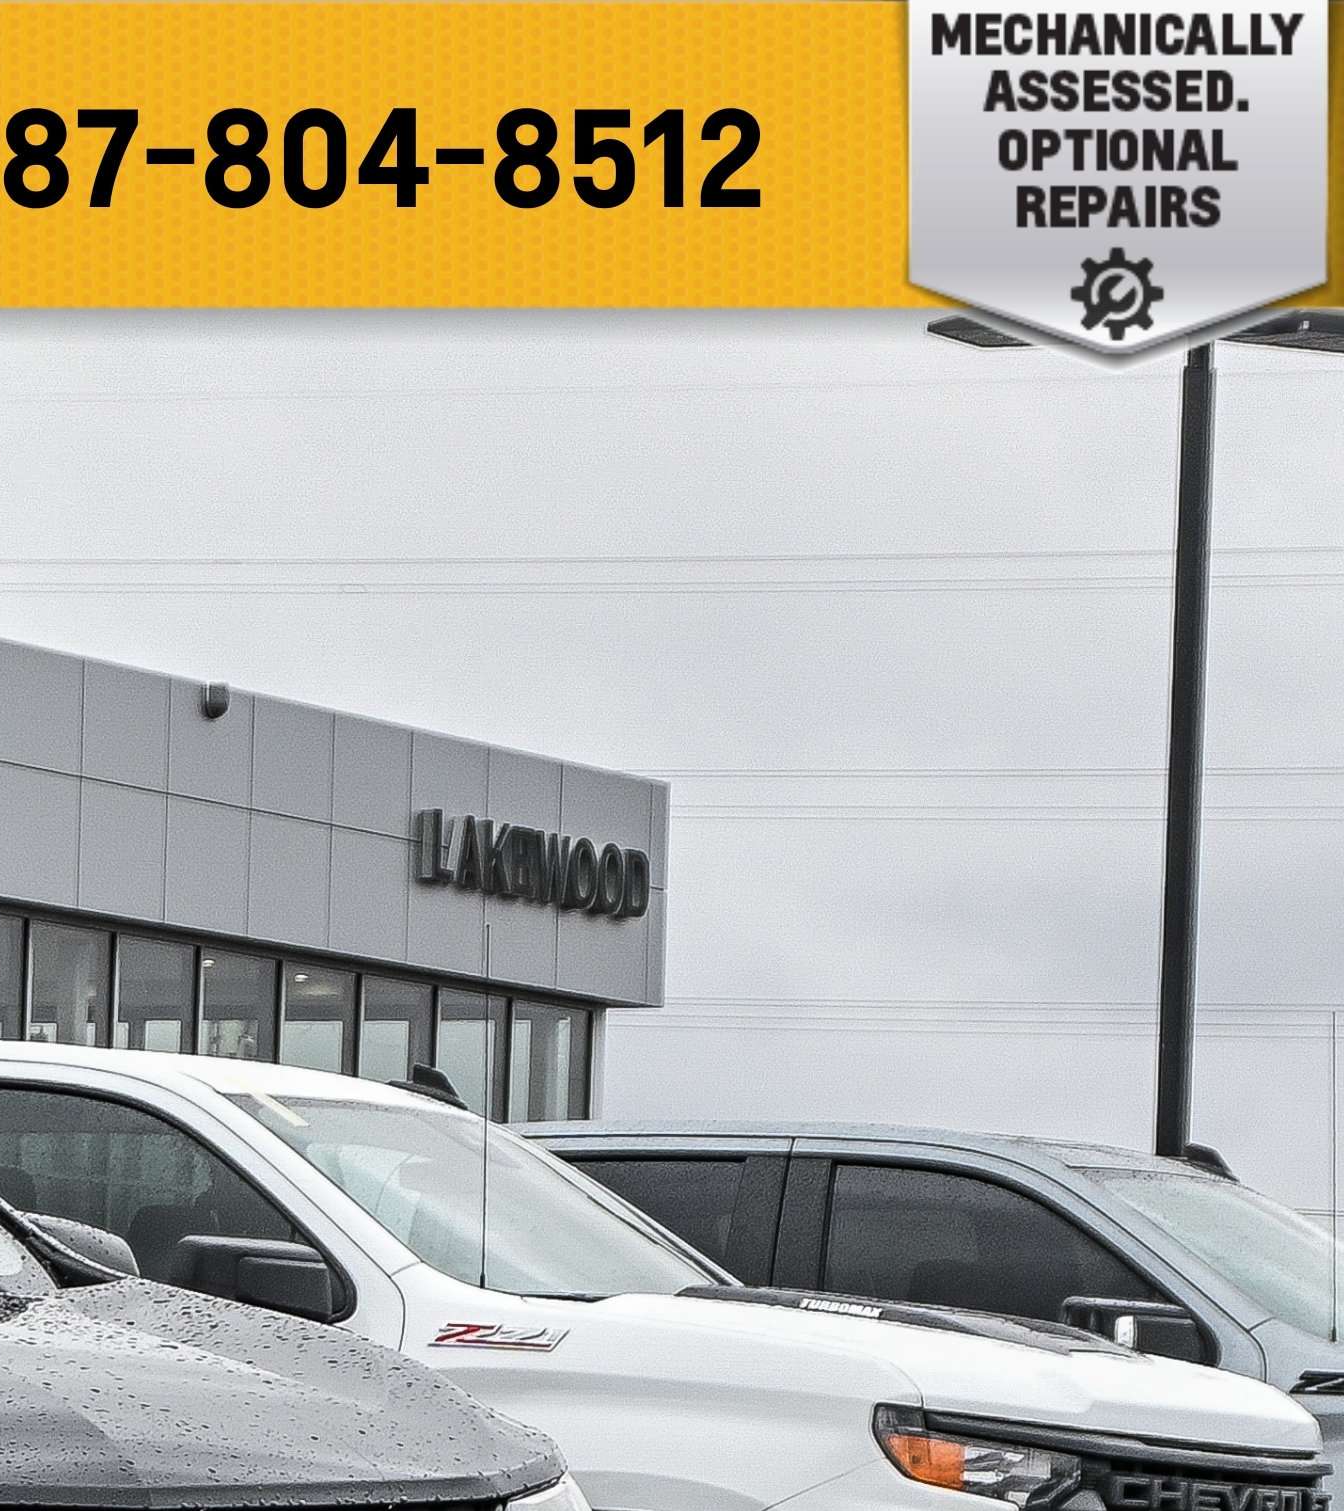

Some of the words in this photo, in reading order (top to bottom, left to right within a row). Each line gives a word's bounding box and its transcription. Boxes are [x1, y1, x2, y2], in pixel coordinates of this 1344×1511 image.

[415, 808, 650, 918] LAKEWOOD
[799, 1298, 883, 1318] TURBOMAX
[432, 1322, 566, 1352] Z71
